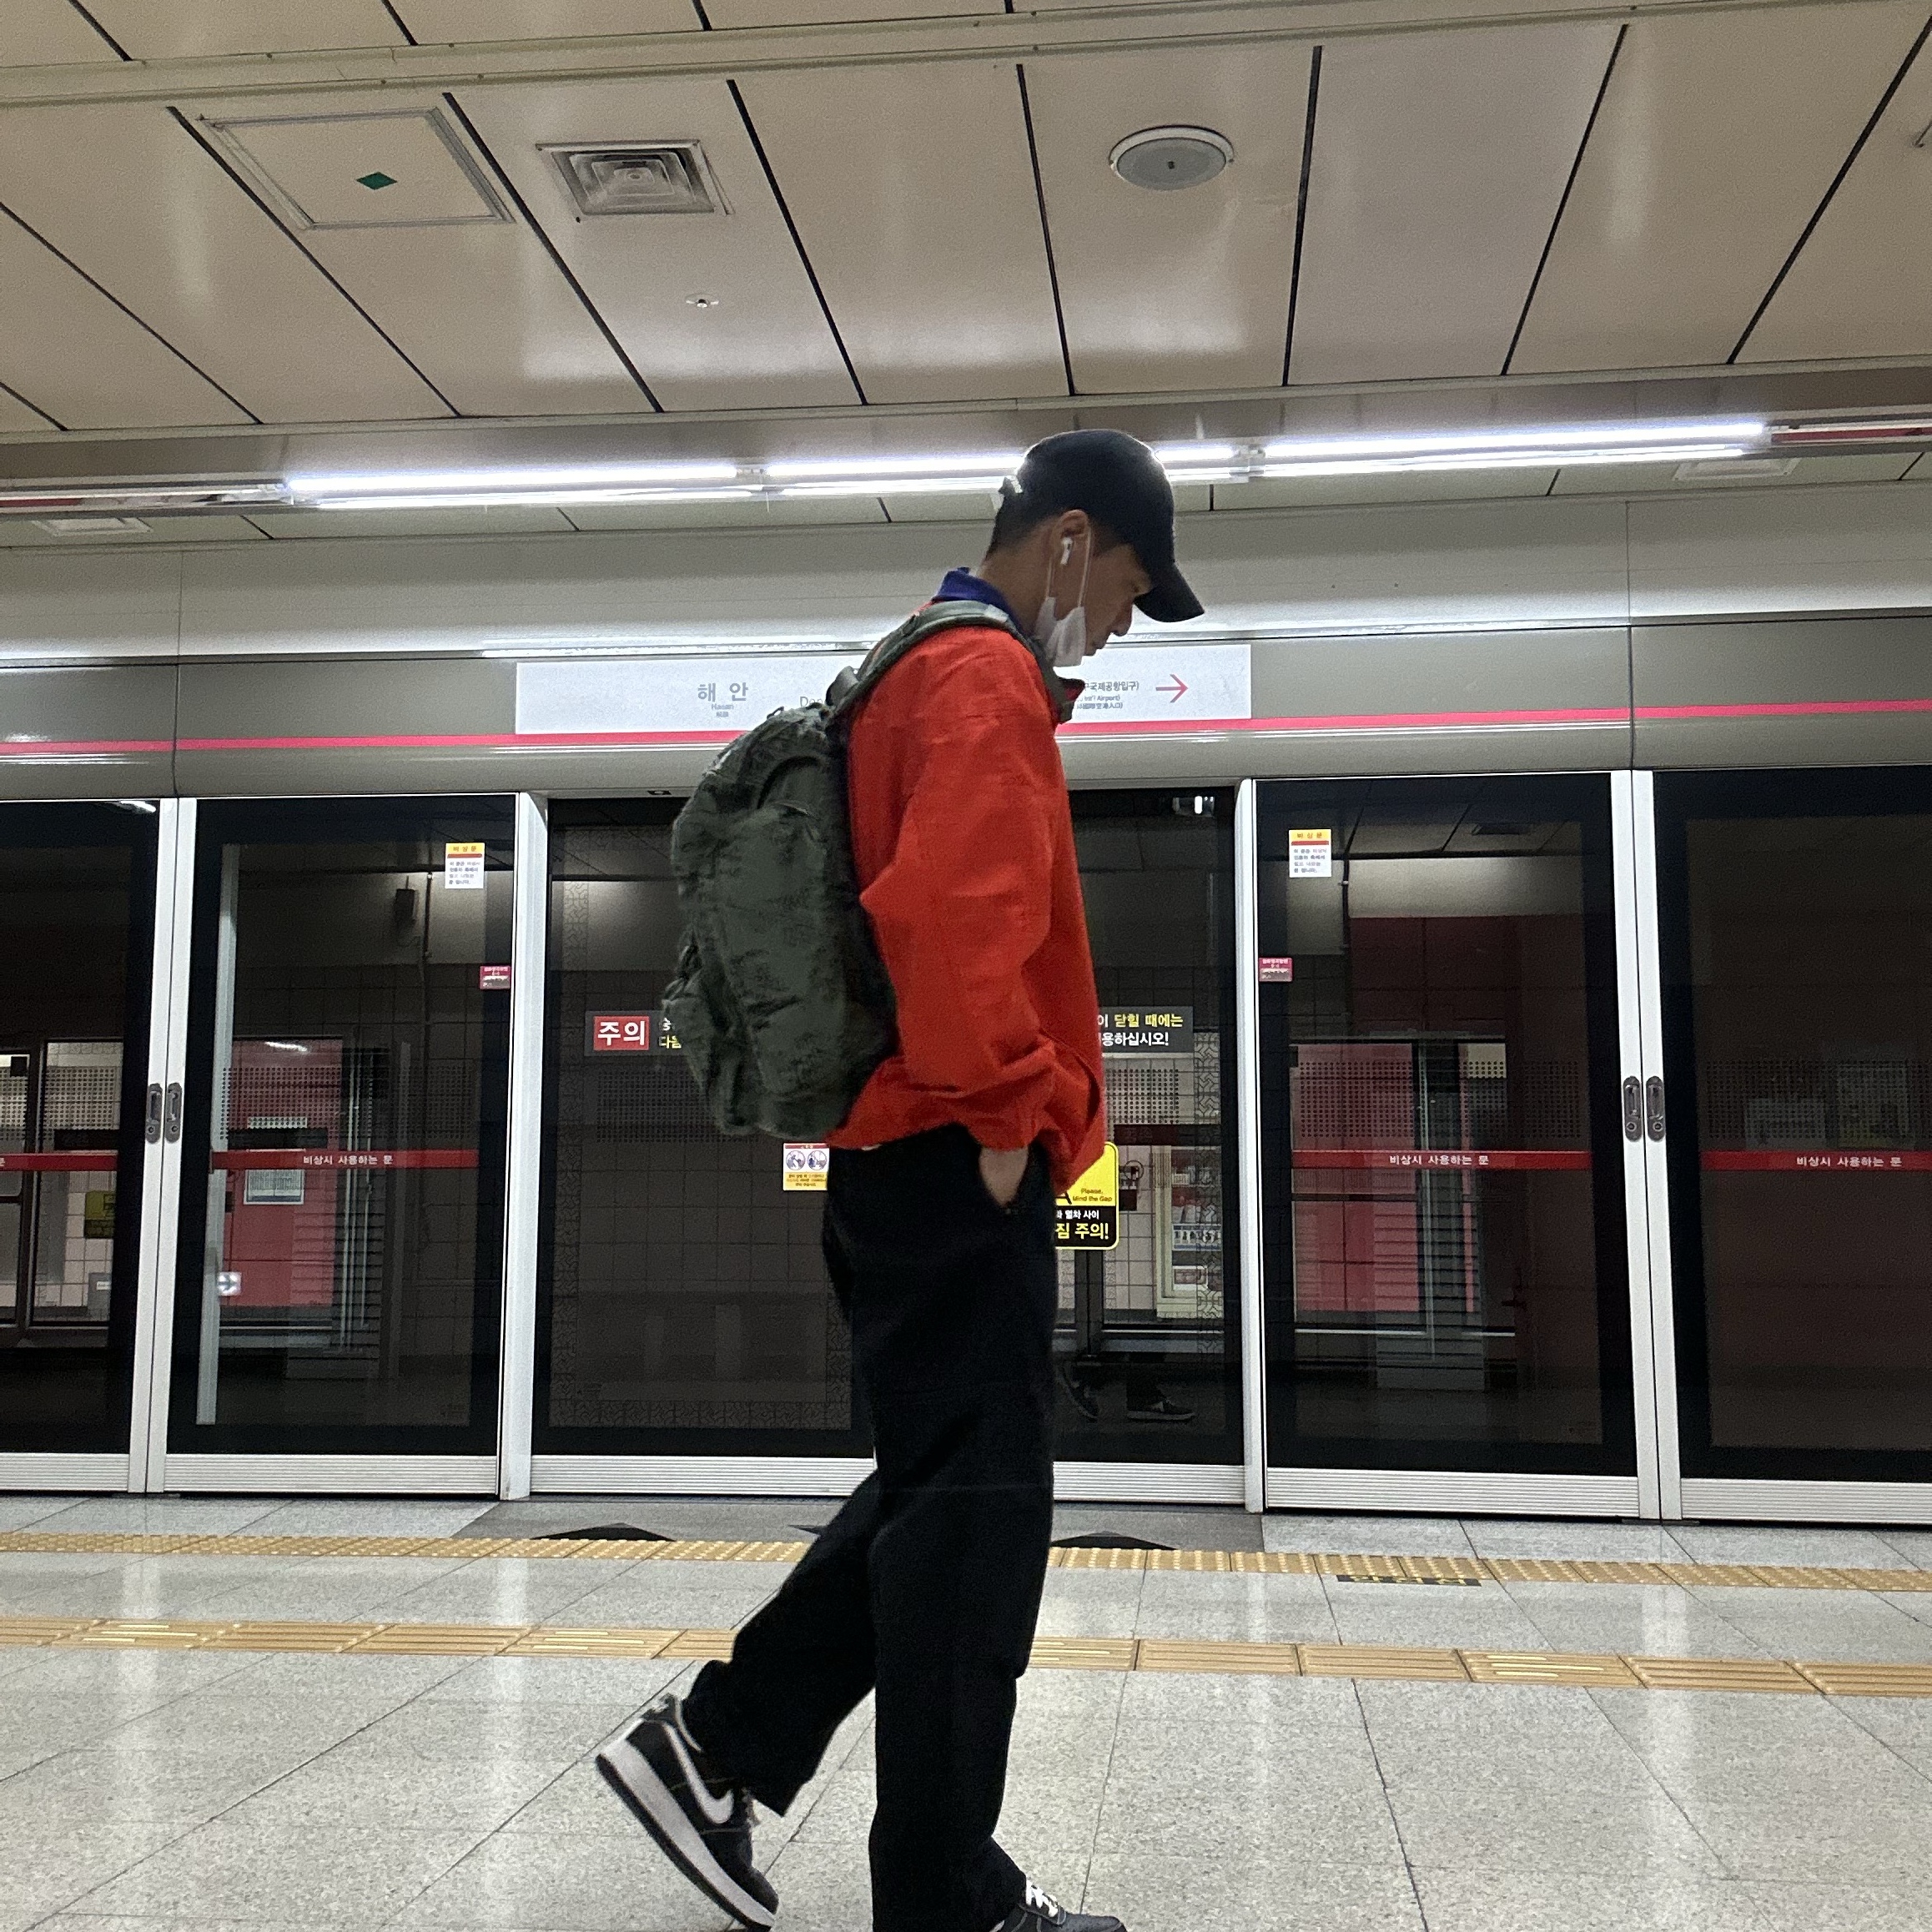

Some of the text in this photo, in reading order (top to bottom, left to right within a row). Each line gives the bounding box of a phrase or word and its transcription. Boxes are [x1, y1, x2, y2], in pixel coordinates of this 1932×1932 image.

[1114, 1013, 1140, 1028] 닫힐
[1145, 1013, 1184, 1028] 때에는
[597, 1020, 646, 1047] 주의
[303, 1155, 394, 1166] 비상시 사용하는 문
[1389, 1155, 1490, 1166] 비상시 사용하는 문
[1796, 1155, 1903, 1168] 비상시 사용하는 문
[1064, 1209, 1082, 1220] 열차
[1083, 1209, 1099, 1220] 사이
[1074, 1222, 1109, 1240] 주의!
